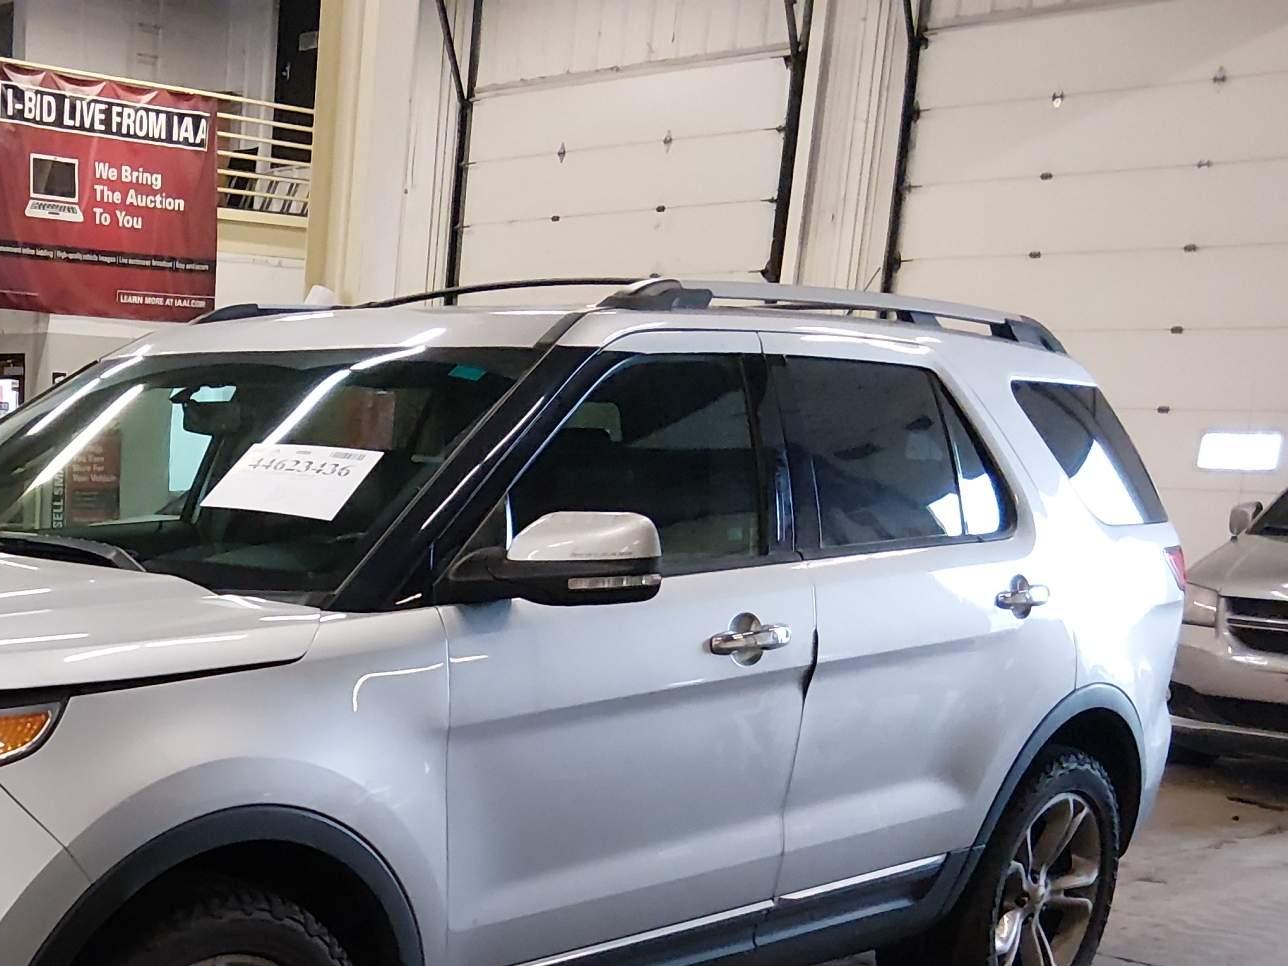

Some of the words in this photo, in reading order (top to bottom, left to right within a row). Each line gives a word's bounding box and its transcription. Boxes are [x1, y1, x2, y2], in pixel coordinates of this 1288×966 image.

[6, 88, 56, 123] I-BID
[63, 98, 107, 131] LIVE
[112, 105, 167, 140] FROM
[94, 161, 118, 181] We
[121, 165, 162, 190] Bring
[94, 184, 122, 204] The
[125, 189, 185, 212] Auction
[93, 207, 111, 226] To
[115, 209, 142, 230] You
[248, 457, 353, 478] 44623436
